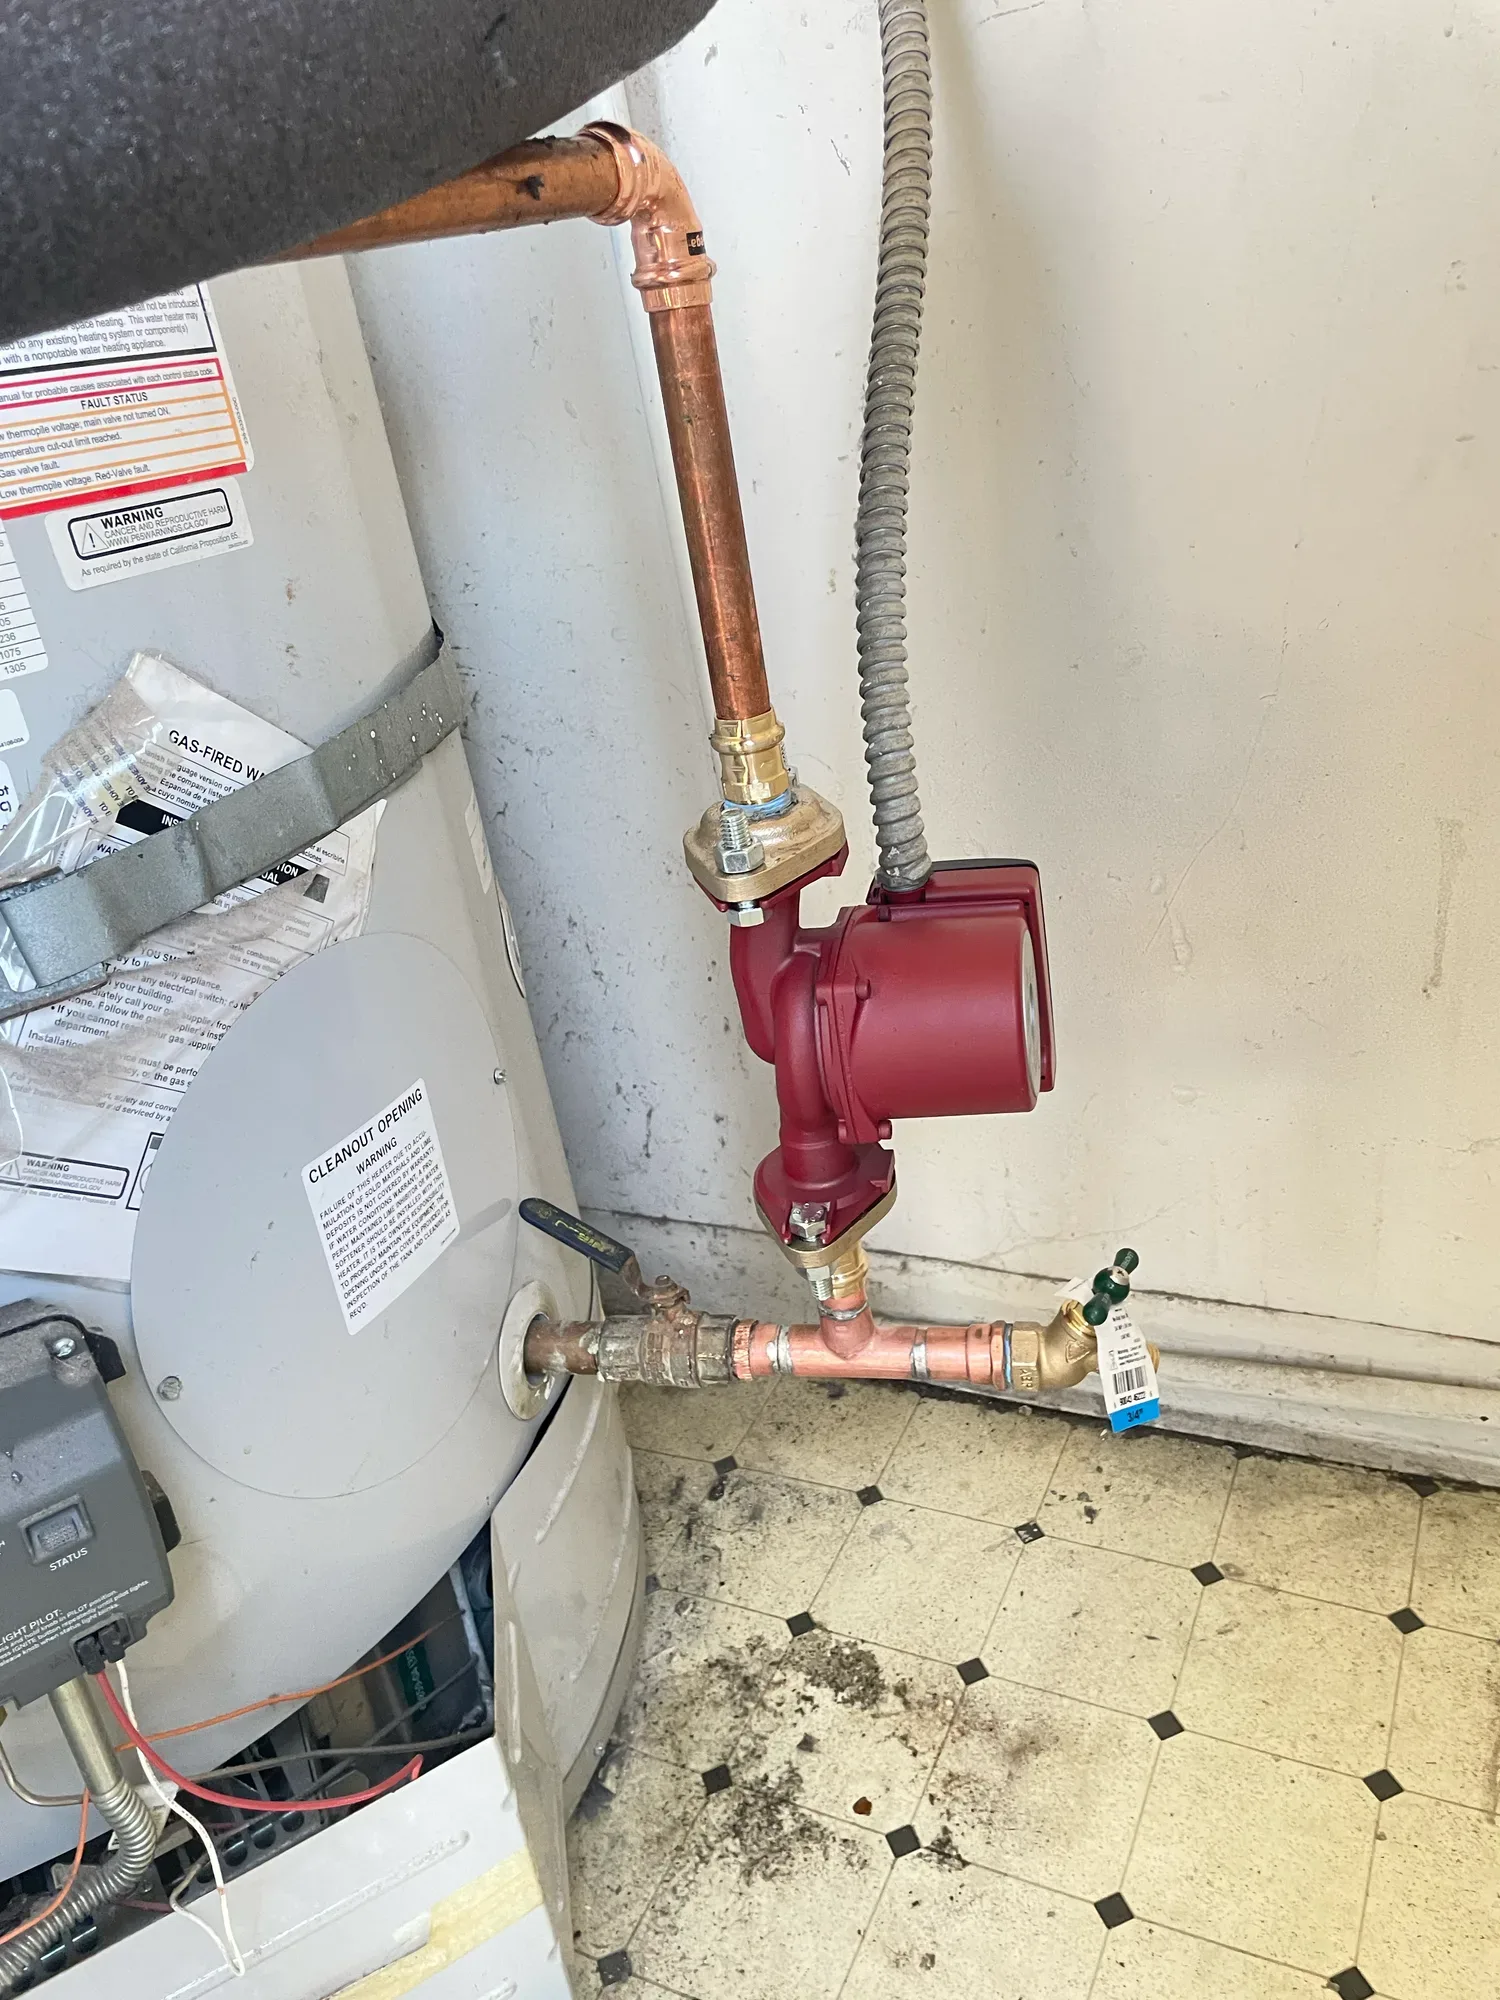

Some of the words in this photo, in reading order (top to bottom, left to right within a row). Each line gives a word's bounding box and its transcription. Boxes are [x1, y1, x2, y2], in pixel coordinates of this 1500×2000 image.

[168, 299, 199, 309] introduced
[128, 314, 144, 325] This
[144, 314, 163, 323] water
[164, 312, 185, 321] heater
[186, 312, 199, 321] may
[28, 338, 44, 349] any
[46, 334, 77, 346] existing
[78, 331, 108, 343] heating
[109, 329, 137, 341] system
[137, 328, 143, 336] or
[144, 324, 189, 336] component(s)
[3, 353, 22, 365] with
[24, 354, 30, 362] a
[31, 347, 78, 361] nonpotable
[80, 345, 101, 355] water
[103, 342, 131, 353] heating
[132, 339, 166, 350] appliance.
[22, 390, 33, 399] for
[34, 385, 69, 397] probable
[70, 382, 96, 392] causes
[97, 376, 132, 389] associated
[133, 375, 146, 385] with
[147, 372, 162, 383] each
[163, 370, 182, 380] control
[183, 368, 199, 378] status
[200, 367, 215, 377] code.
[80, 396, 112, 410] FAULT
[113, 391, 149, 405] STATUS
[6, 425, 50, 440] thermopile
[50, 420, 83, 432] voltage;
[83, 417, 103, 427] main
[103, 414, 122, 424] valve
[123, 411, 135, 421] not
[135, 408, 157, 419] turned
[157, 406, 171, 416] ON.
[46, 440, 75, 452] cut-out
[75, 436, 91, 447] limit
[91, 431, 123, 445] reached.
[0, 469, 16, 479] Gas
[17, 464, 40, 477] valve
[40, 460, 60, 471] fault.
[0, 489, 18, 499] Low
[19, 480, 63, 496] thermopile
[63, 474, 95, 487] voltage.
[95, 467, 133, 482] Red-Valve
[133, 463, 151, 475] fault.
[101, 507, 165, 530] WARNING
[104, 525, 138, 539] CANCER
[139, 522, 155, 535] AND
[155, 511, 208, 529] REPRODUCTIVE
[208, 504, 227, 517] HARM
[106, 517, 210, 548] WWW.P65WARNINGS.CA.GOV
[81, 568, 92, 577] As
[93, 560, 122, 575] required
[122, 559, 132, 570] by
[132, 555, 144, 565] the
[144, 552, 162, 563] state
[163, 549, 170, 558] of
[169, 542, 199, 557] California
[200, 535, 231, 549] Proposition
[231, 532, 240, 542] 65.
[4, 662, 27, 675] 1305
[168, 730, 243, 774] GAS-FIRED
[157, 789, 175, 800] cuyo
[160, 778, 192, 796] Espanola
[193, 792, 202, 801] de
[177, 775, 207, 793] company
[200, 774, 223, 789] version
[224, 785, 232, 793] of
[131, 957, 141, 967] to
[114, 980, 136, 992] your
[137, 986, 174, 1004] building.
[141, 975, 158, 987] any
[158, 979, 198, 996] electrical
[198, 989, 228, 1007] switch;
[180, 974, 223, 992] appliance.
[57, 1004, 66, 1014] If
[66, 1007, 86, 1019] you
[87, 1014, 120, 1028] cannot
[98, 1001, 130, 1017] Follow
[130, 1009, 145, 1021] the
[124, 997, 141, 1007] call
[142, 1002, 163, 1014] your
[54, 1017, 111, 1039] department.
[168, 1034, 185, 1045] gas
[153, 1072, 169, 1083] the
[169, 1077, 186, 1086] gas
[163, 1062, 174, 1072] be
[121, 1105, 156, 1119] serviced
[155, 1111, 166, 1122] by
[138, 1098, 155, 1108] and
[309, 1126, 374, 1183] CLEANOUT
[377, 1088, 422, 1133] OPENING
[26, 1158, 70, 1172] WARNING
[355, 1136, 397, 1175] WARNING
[319, 1196, 346, 1220] FAILURE
[347, 1188, 355, 1200] OF
[356, 1177, 370, 1191] THIS
[371, 1159, 392, 1181] HEATER
[392, 1149, 404, 1163] DUE
[322, 1202, 355, 1230] MULATION
[355, 1194, 363, 1205] OF
[364, 1181, 381, 1198] SOLID
[381, 1156, 410, 1184] MATERIALS
[410, 1146, 420, 1159] AND
[325, 1213, 356, 1240] DEPOSITS
[356, 1207, 363, 1216] IS
[363, 1196, 376, 1210] NOT
[377, 1175, 401, 1200] COVERED
[328, 1240, 334, 1250] IF
[335, 1224, 357, 1244] WATER
[358, 1195, 392, 1228] CONDITIONS
[331, 1243, 349, 1260] PERLY
[350, 1216, 382, 1245] MAINTAINED
[383, 1205, 395, 1219] LIME
[395, 1184, 418, 1208] INHIBITOR
[335, 1242, 365, 1270] SOFTENER
[366, 1223, 388, 1245] SHOULD
[388, 1216, 396, 1226] BE
[396, 1193, 421, 1219] INSTALLED
[362, 1250, 368, 1260] IT
[369, 1245, 376, 1254] IS
[376, 1235, 387, 1248] THE
[388, 1215, 410, 1238] OWNER'S
[340, 1279, 349, 1289] TO
[349, 1257, 377, 1282] PROPERLY
[377, 1236, 402, 1259] MAINTAIN
[401, 1225, 411, 1236] THE
[343, 1275, 369, 1299] OPENING
[369, 1259, 387, 1279] UNDER
[387, 1249, 399, 1261] THIS
[399, 1234, 415, 1252] COVER
[346, 1277, 380, 1309] INSPECTION
[380, 1270, 388, 1280] OF
[388, 1260, 399, 1272] THE
[399, 1249, 413, 1260] TANK
[413, 1238, 423, 1250] AND
[49, 1547, 88, 1571] STATUS
[10, 1636, 24, 1648] and
[24, 1628, 41, 1641] hold
[41, 1619, 59, 1631] knob
[59, 1615, 66, 1623] in
[66, 1603, 88, 1619] PILOT
[12, 1638, 37, 1654] IGNITE
[38, 1625, 61, 1640] button
[61, 1607, 98, 1628] repeatedly
[97, 1599, 114, 1610] until
[113, 1589, 130, 1602] pilot
[29, 1608, 63, 1630] PILOT:
[22, 1642, 40, 1655] knob
[40, 1633, 60, 1646] when
[60, 1622, 82, 1636] status
[81, 1612, 98, 1625] light
